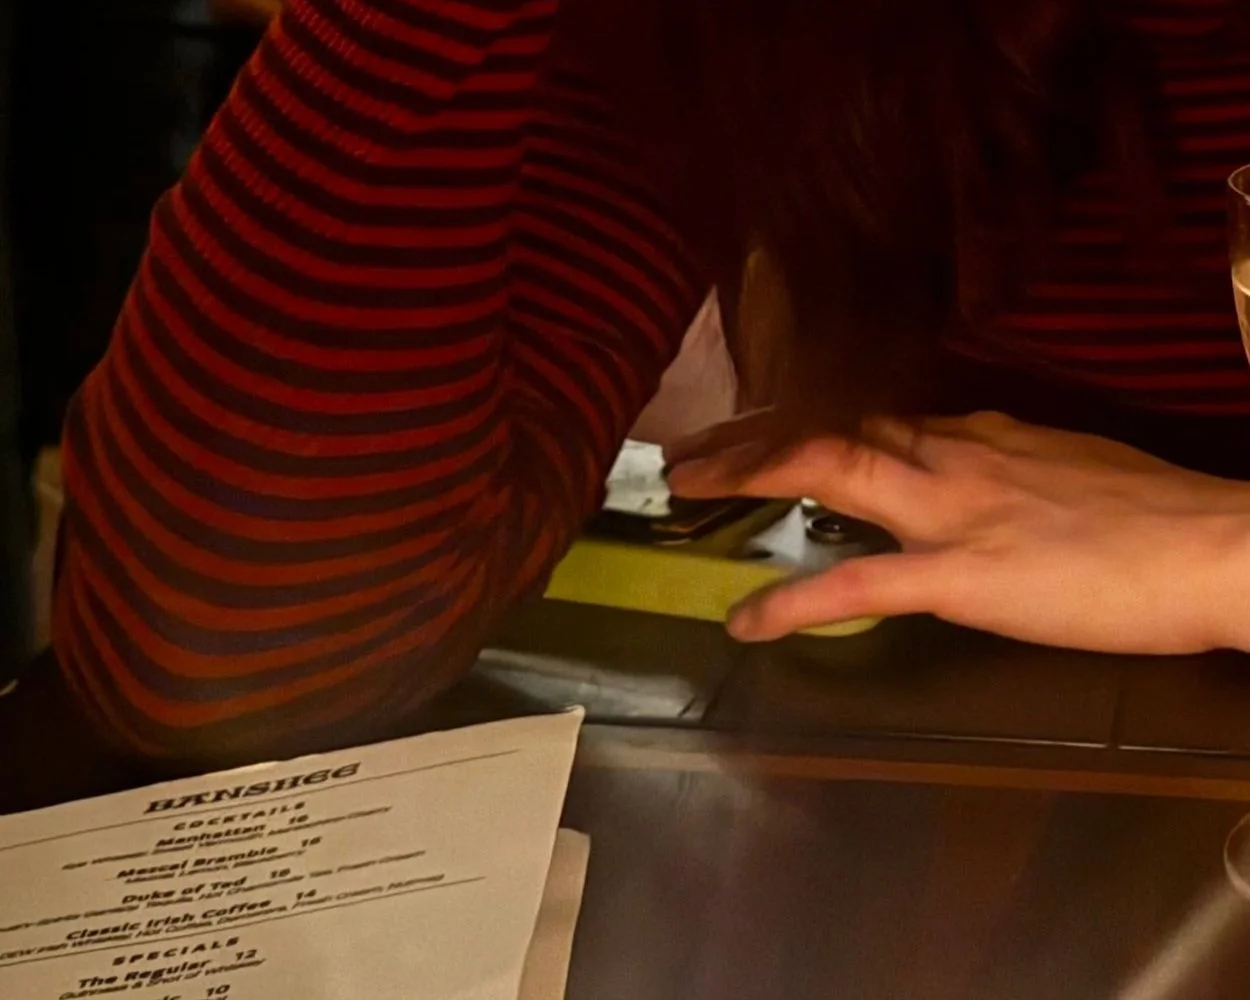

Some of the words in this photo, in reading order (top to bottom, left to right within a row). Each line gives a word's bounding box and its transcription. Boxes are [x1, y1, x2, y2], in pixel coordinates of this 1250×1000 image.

[143, 762, 361, 814] BANSHEE
[173, 802, 305, 831] COCKTAILS
[156, 824, 266, 847] Manhattan
[116, 859, 187, 879] Mezcal
[192, 847, 279, 867] Bramble
[121, 889, 176, 904] Duke
[181, 883, 206, 896] of
[65, 921, 142, 941] Classic
[146, 911, 195, 929] Irish
[201, 898, 273, 920] Coffee
[112, 936, 240, 966] SPECIALS
[78, 975, 118, 989] The
[124, 959, 211, 982] Regular
[235, 949, 258, 961] 12
[205, 984, 231, 998] 10
